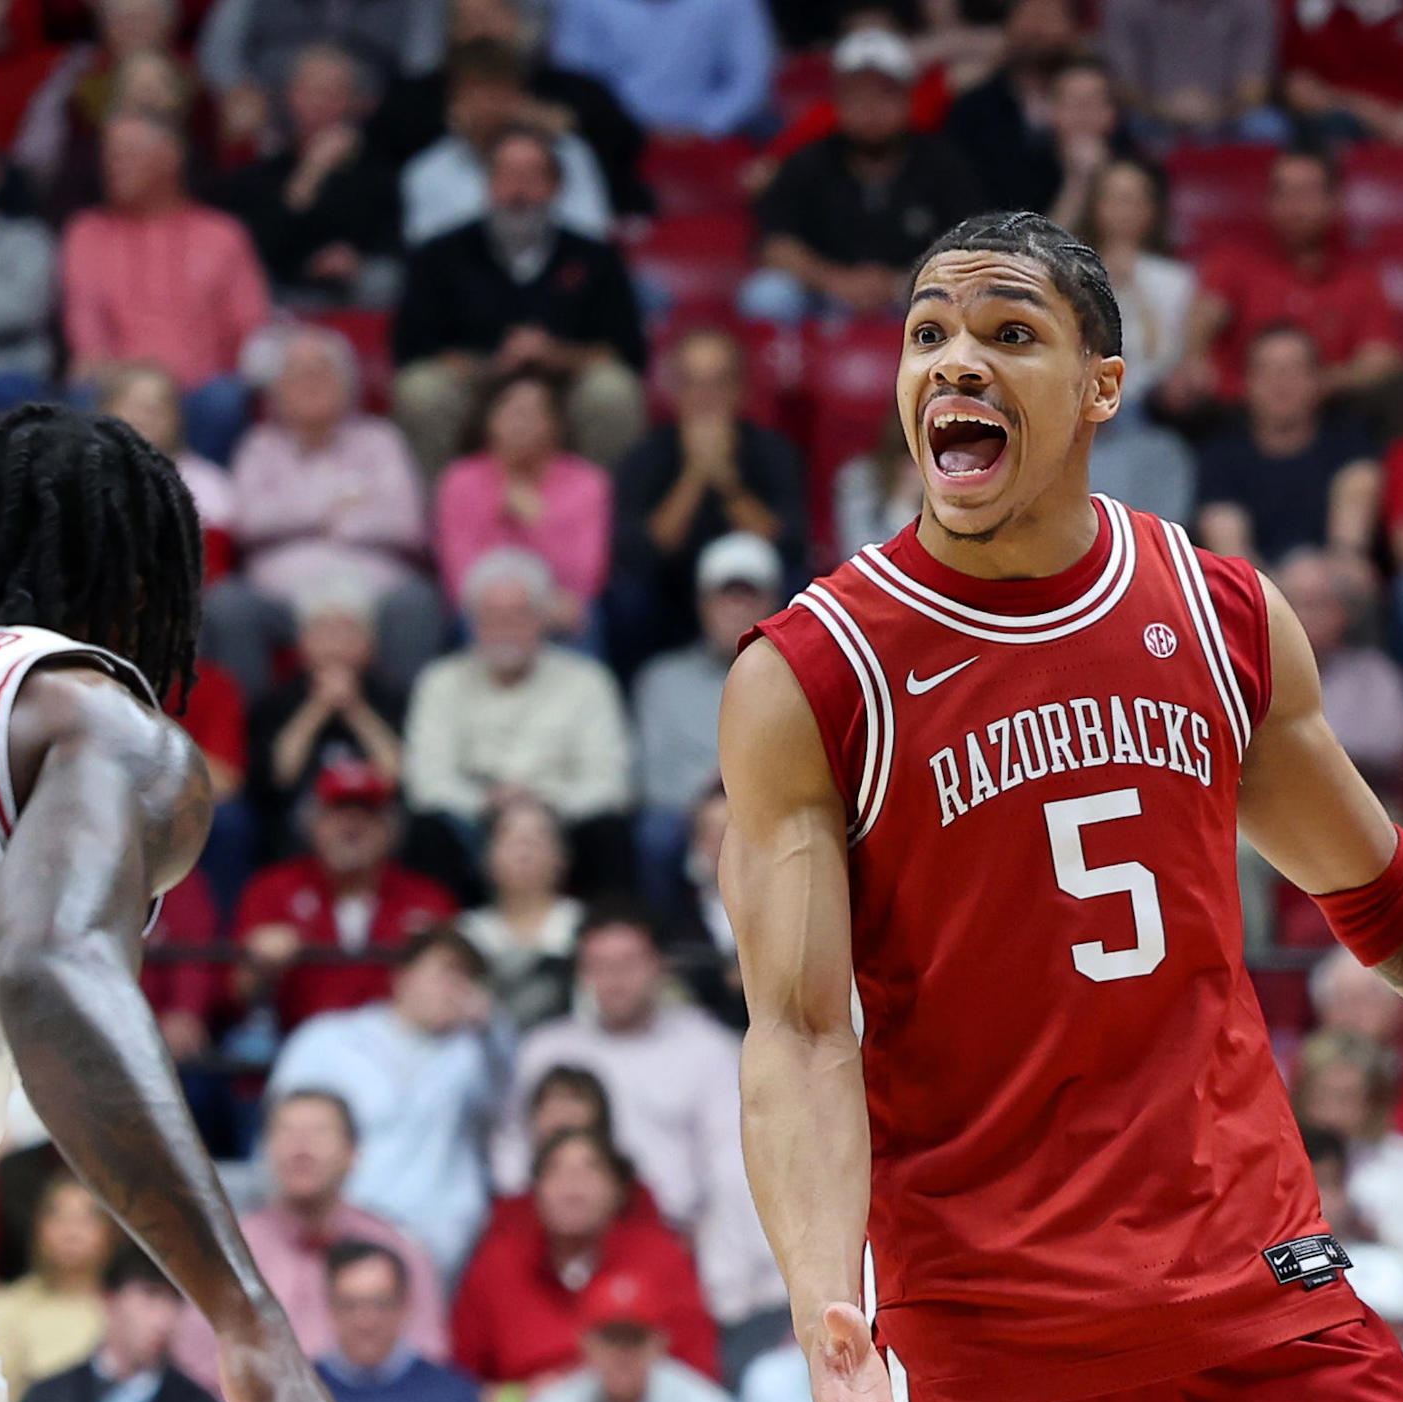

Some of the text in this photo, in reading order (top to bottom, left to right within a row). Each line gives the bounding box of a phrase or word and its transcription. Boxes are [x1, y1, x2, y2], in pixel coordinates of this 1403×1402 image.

[1145, 625, 1176, 657] SEC
[929, 694, 1212, 828] RAZORBACKS
[1043, 787, 1166, 983] 5
